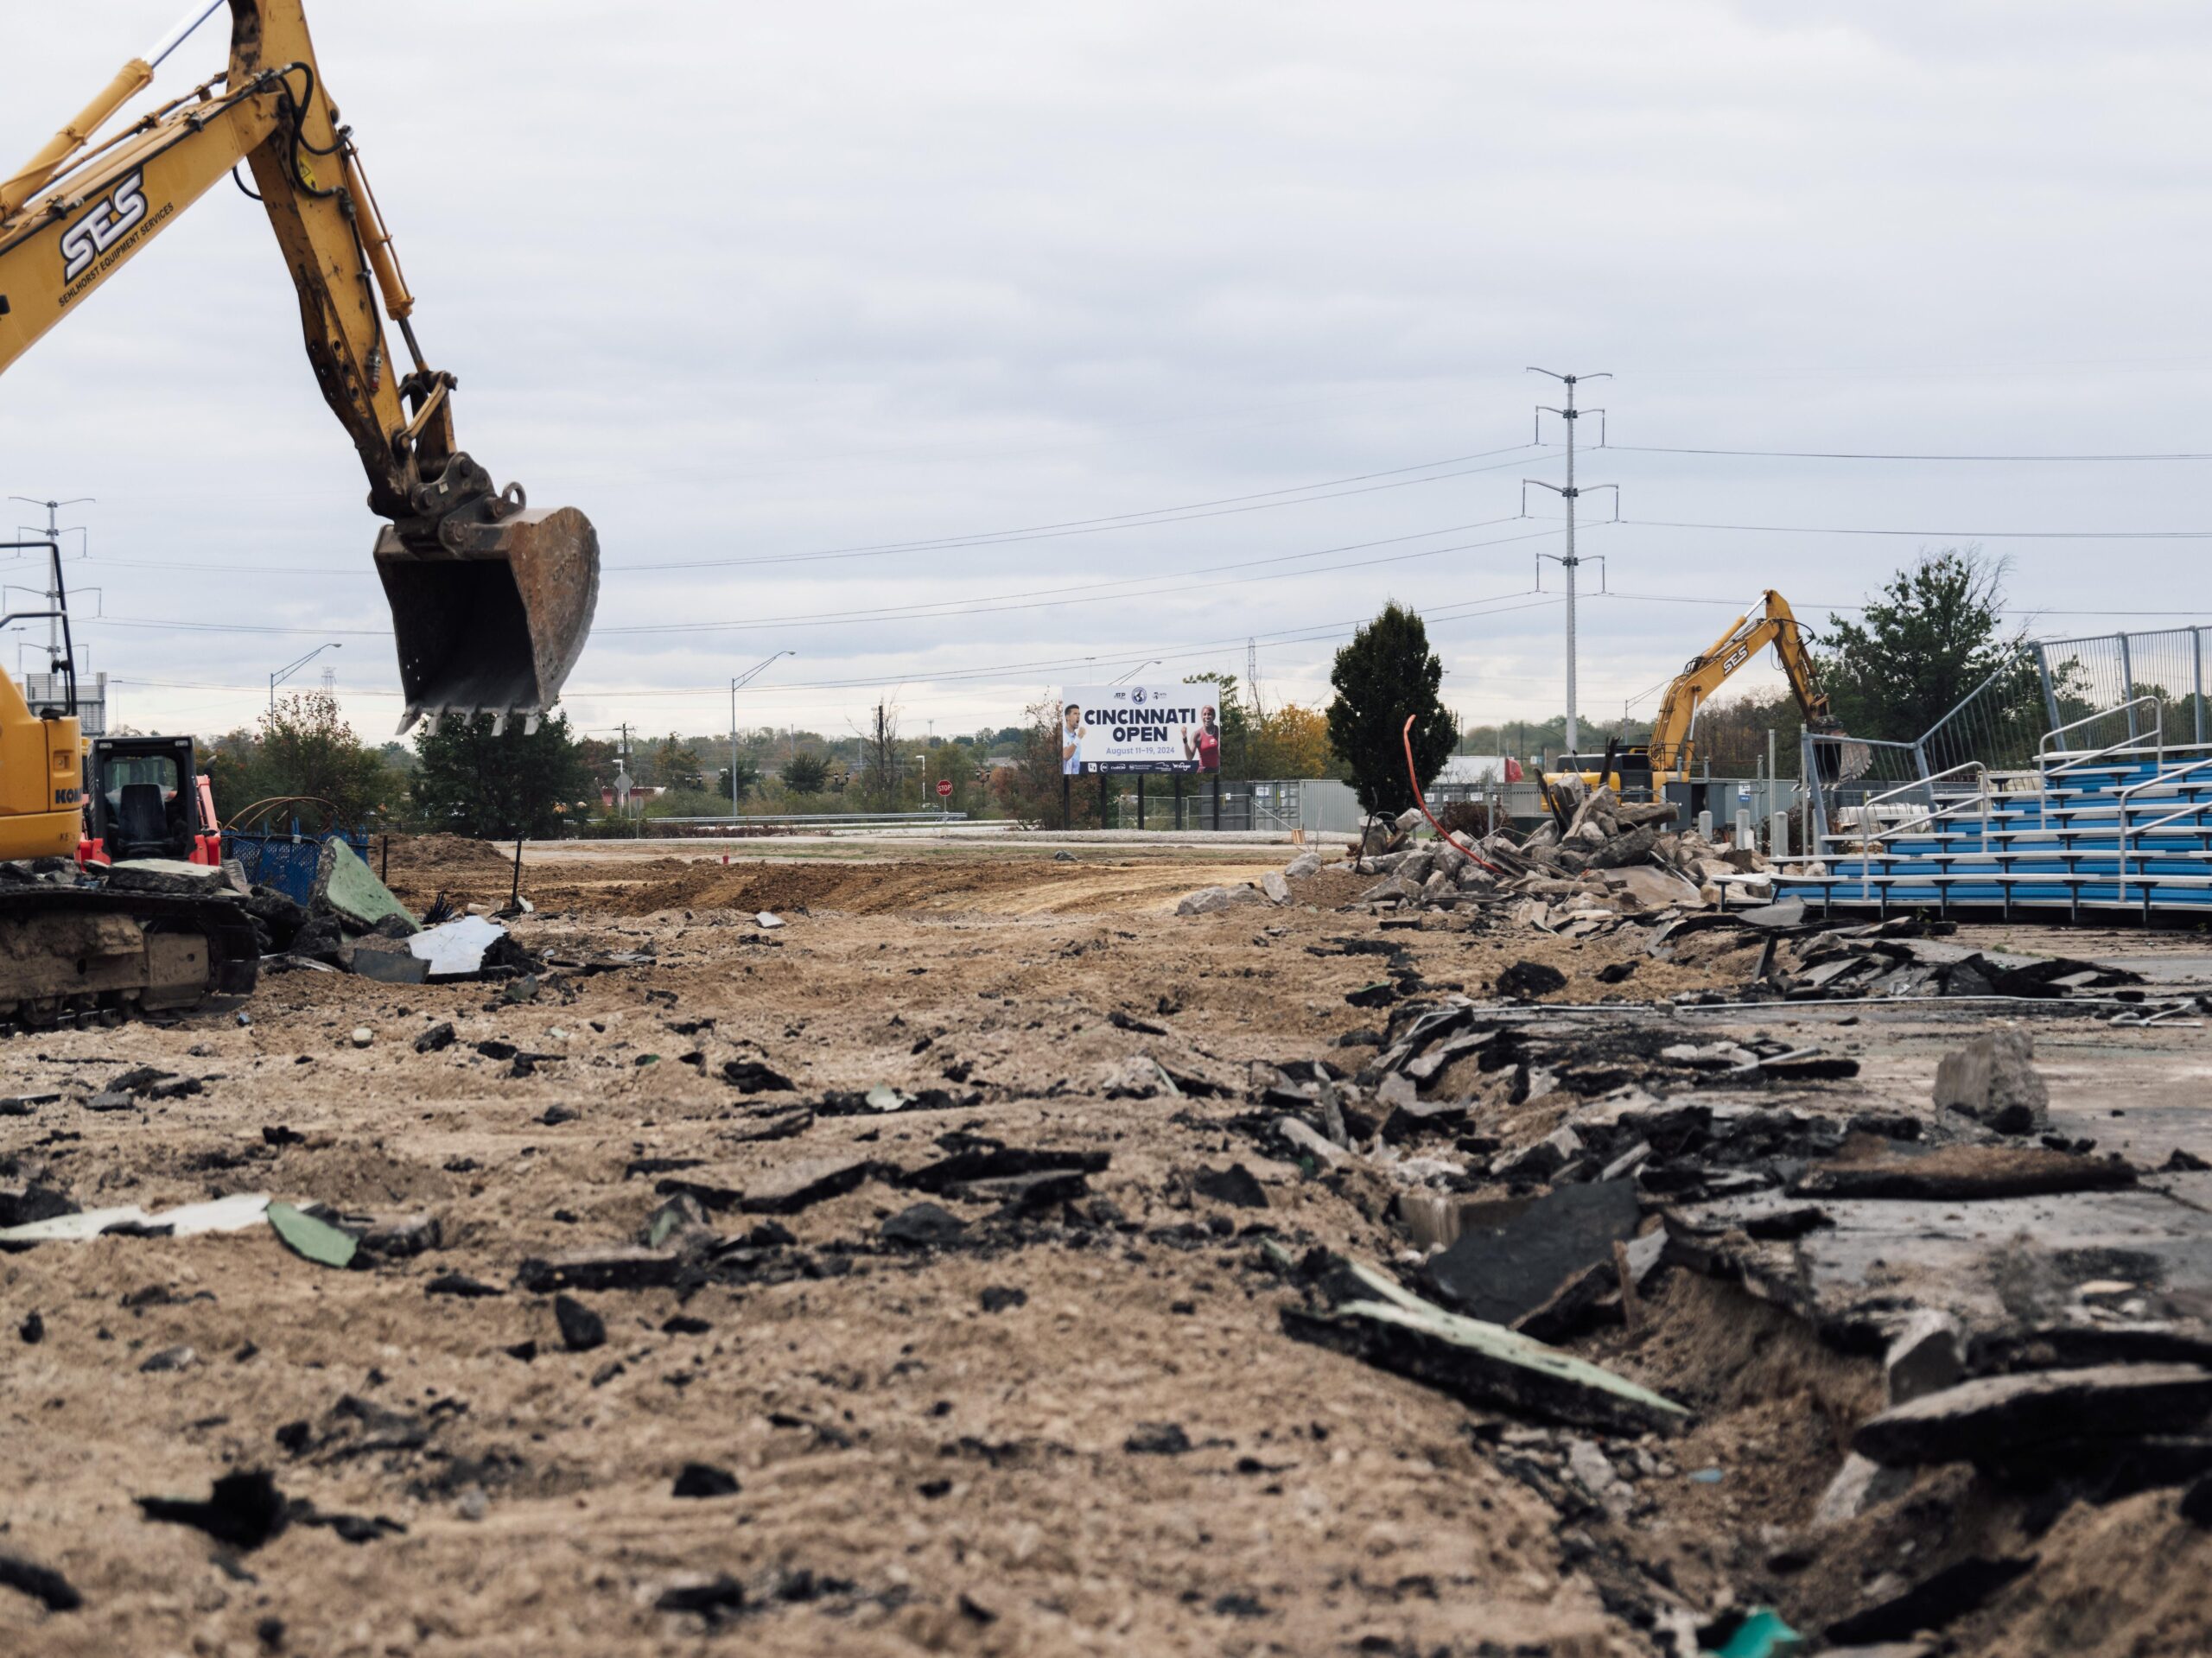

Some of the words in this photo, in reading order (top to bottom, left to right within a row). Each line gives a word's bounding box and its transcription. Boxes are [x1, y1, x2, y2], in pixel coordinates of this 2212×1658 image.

[60, 168, 148, 284] SES
[59, 266, 99, 307] SEHLHORST
[100, 232, 140, 271] EQUIPMENT
[140, 202, 174, 235] SERVICES
[1723, 645, 1749, 676] SES
[1084, 708, 1196, 725] CINCINNATI
[1113, 727, 1167, 742] OPEN
[1106, 746, 1134, 757] August
